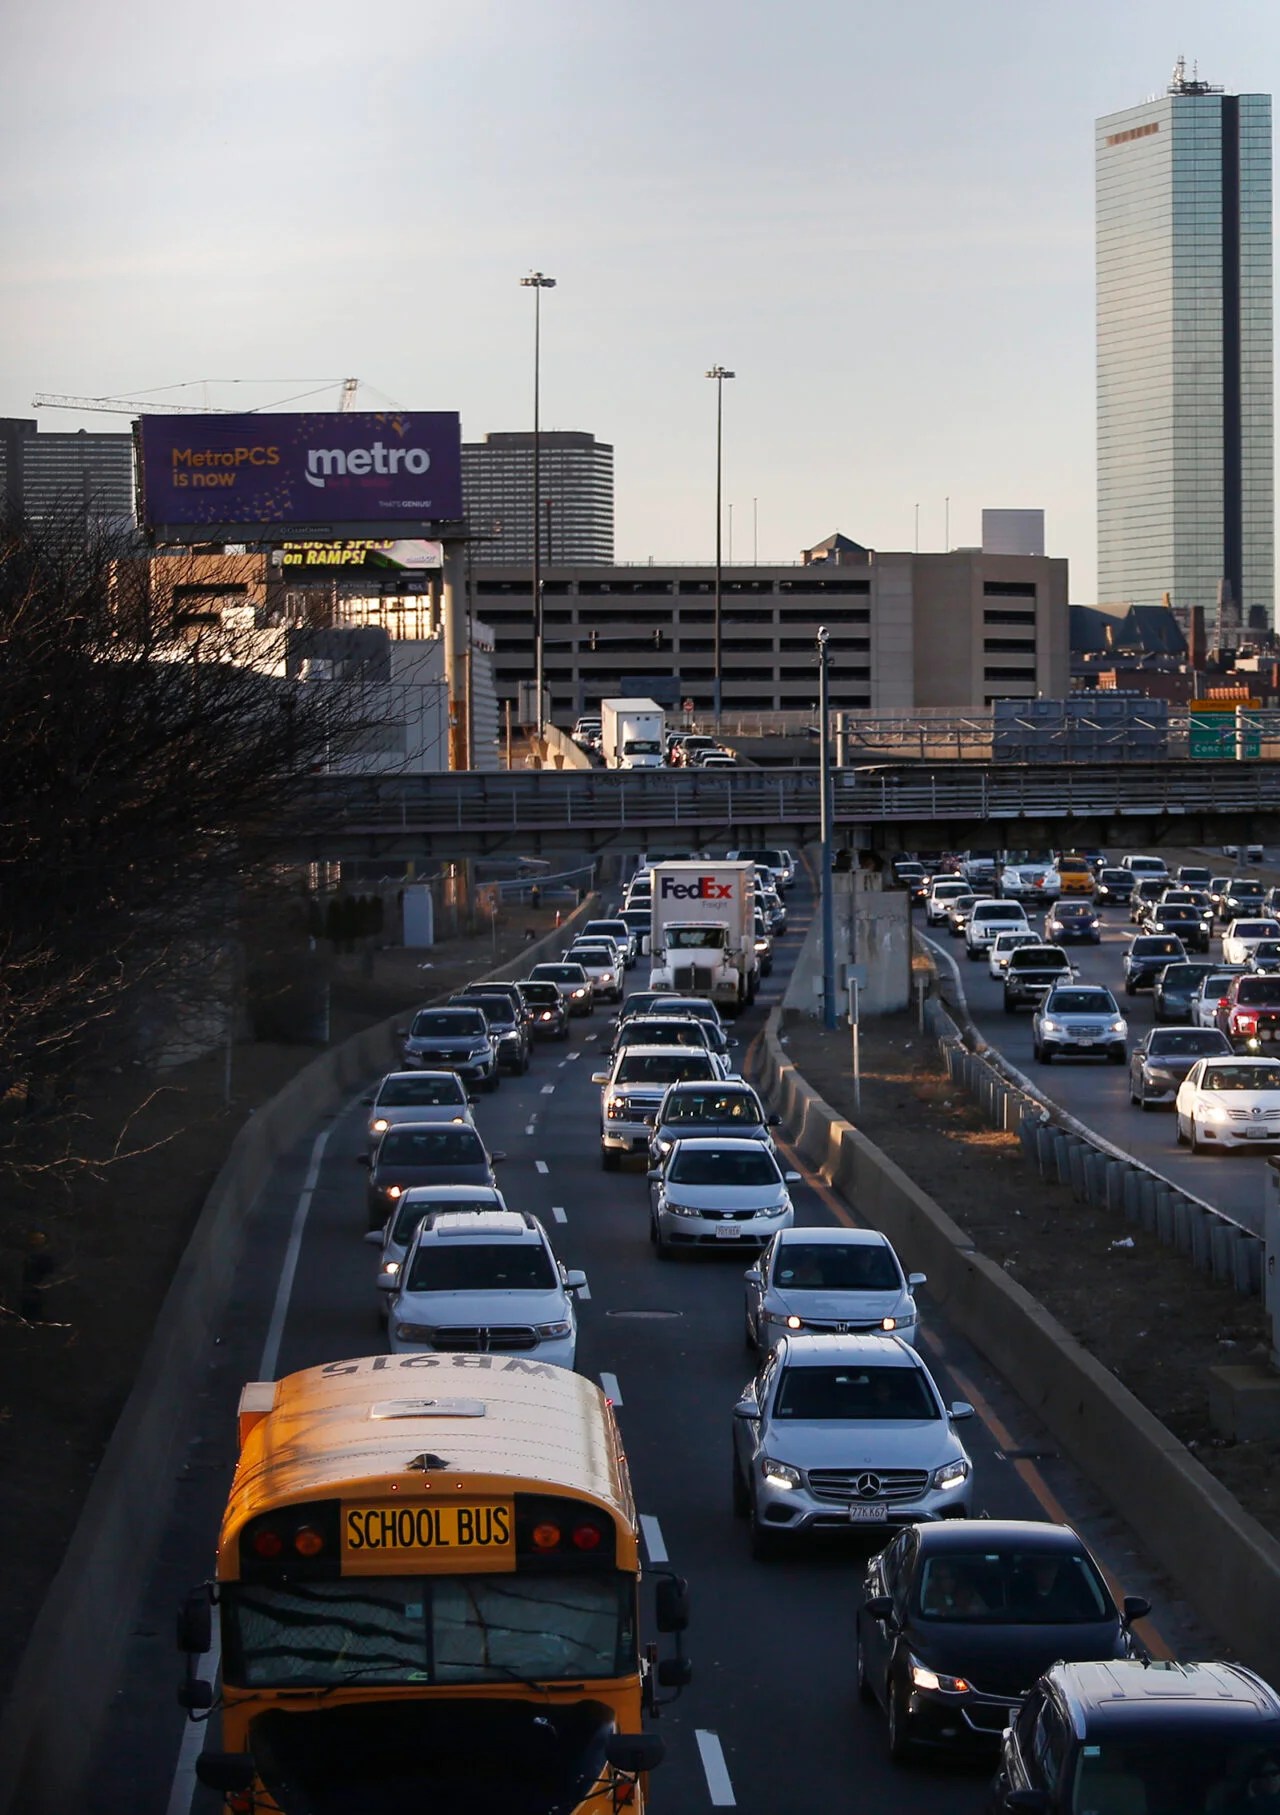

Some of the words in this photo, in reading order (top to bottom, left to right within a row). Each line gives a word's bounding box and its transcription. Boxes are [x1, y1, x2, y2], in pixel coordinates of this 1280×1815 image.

[171, 446, 280, 467] MetroPCS
[305, 442, 431, 480] metro
[172, 468, 189, 487] is
[192, 472, 237, 488] now
[401, 500, 432, 508] GENIUS!
[282, 552, 303, 566] on
[305, 549, 367, 566] RAMPS!
[661, 876, 734, 900] FedEx
[702, 900, 728, 911] Freight
[321, 1354, 561, 1381] WB915
[347, 1508, 450, 1549] SCHOOL
[456, 1506, 510, 1546] BUS
